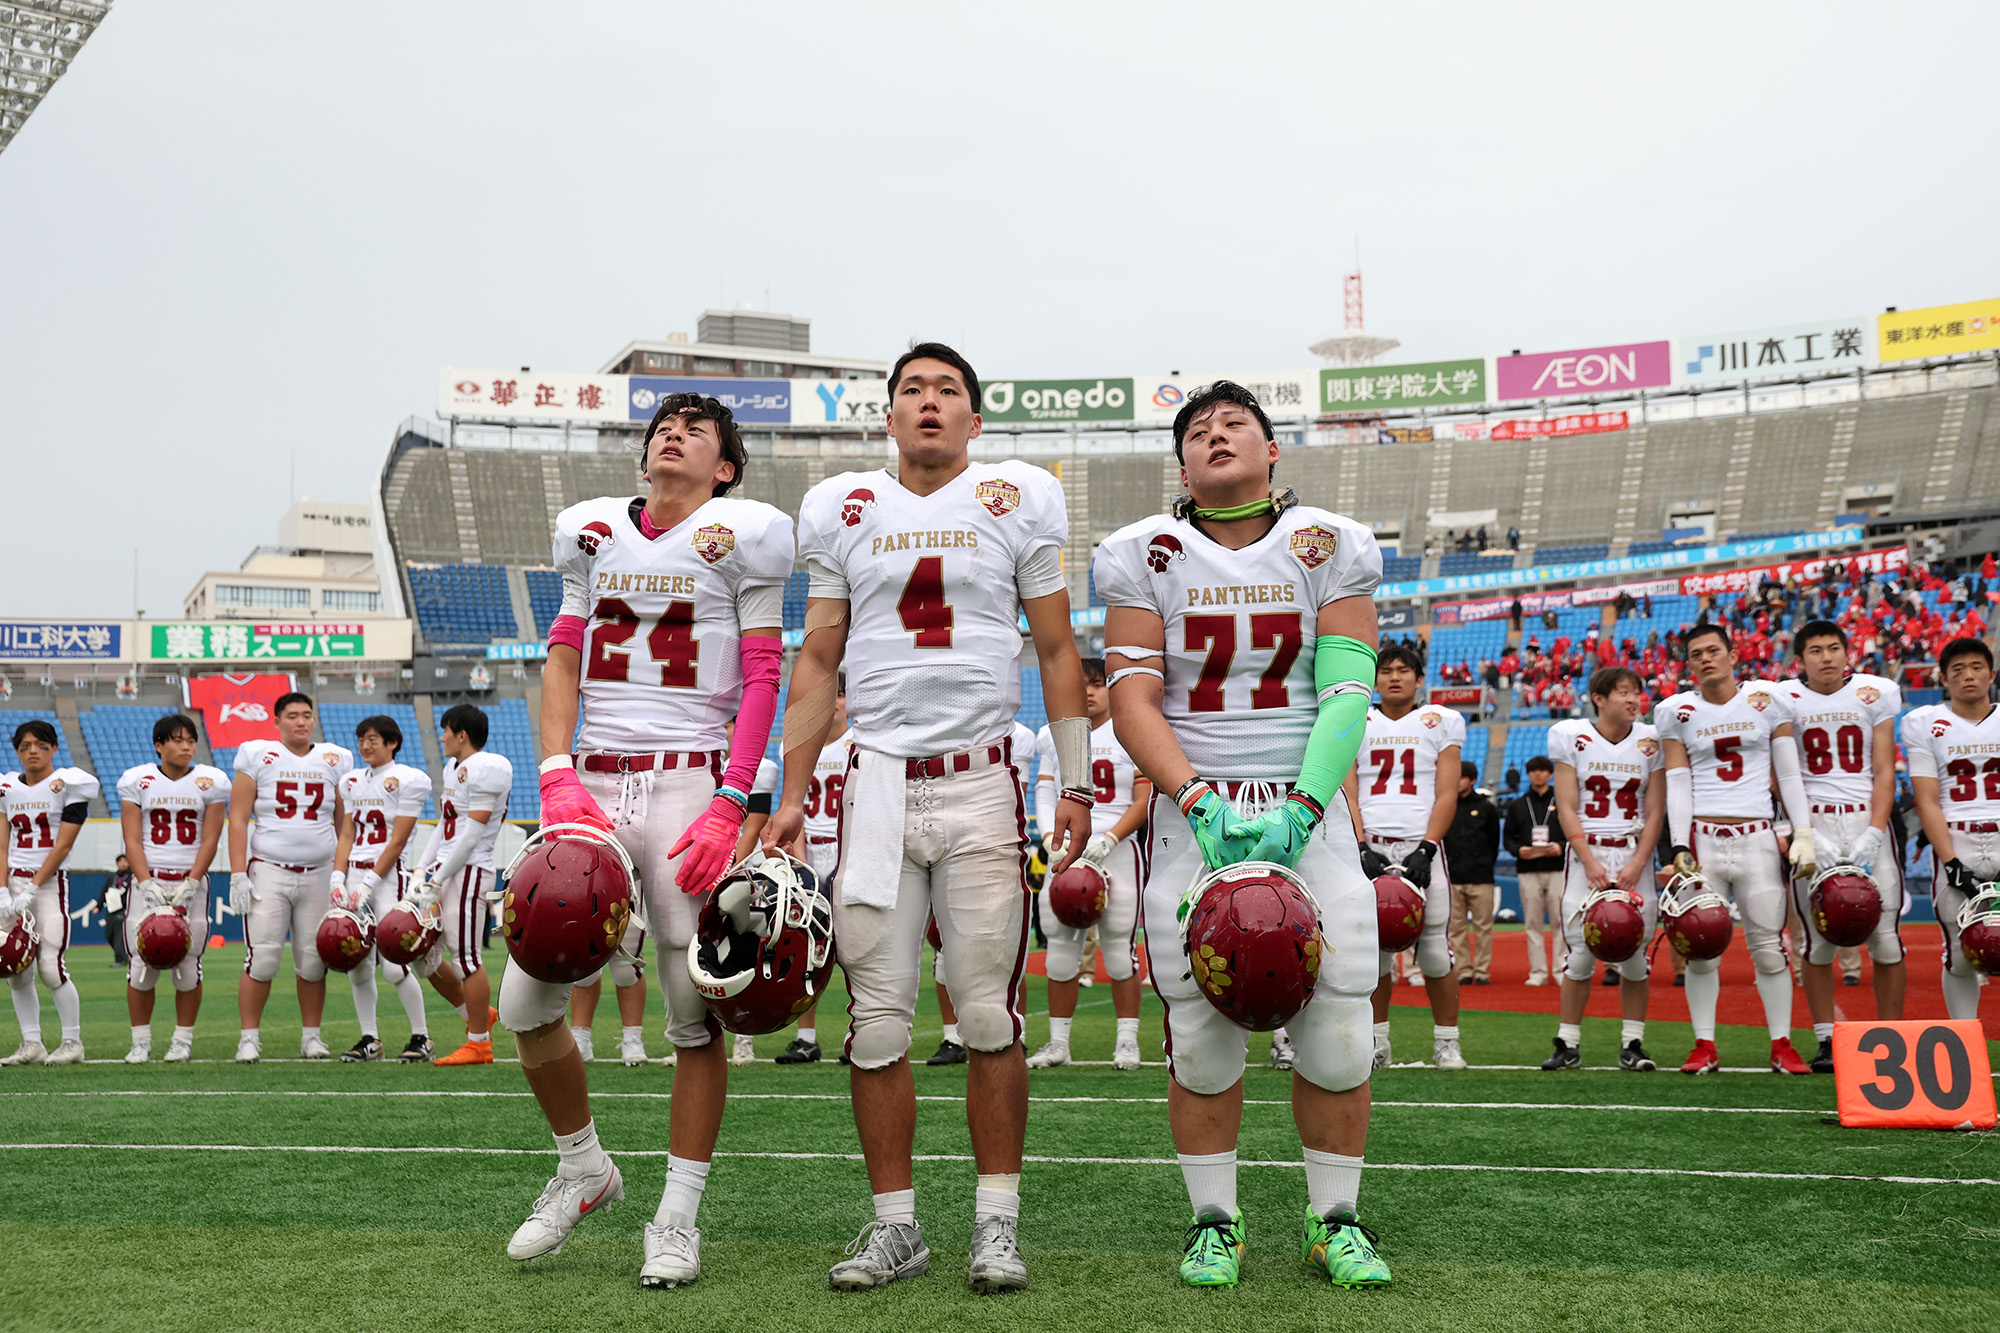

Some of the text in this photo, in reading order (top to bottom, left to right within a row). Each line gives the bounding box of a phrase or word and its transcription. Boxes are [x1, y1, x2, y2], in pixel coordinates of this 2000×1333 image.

[1886, 321, 1965, 345] 東洋水産
[1720, 327, 1862, 372] 川本工業
[1021, 381, 1126, 410] onedo
[1326, 369, 1480, 404] 関東学院大学
[976, 485, 1021, 508] PANTHERS
[691, 531, 736, 551] PANTHERS
[872, 530, 978, 555] PANTHERS
[1289, 534, 1337, 555] PANTHERS
[1793, 530, 1857, 550] SENDA
[596, 572, 695, 594] PANTHERS
[1187, 584, 1295, 606] PANTHERS
[896, 555, 954, 649] 4
[586, 597, 699, 689] 24
[1183, 612, 1303, 713] 77
[1696, 721, 1756, 739] PANTHERS
[1801, 711, 1860, 726] PANTHERS
[1369, 735, 1420, 746] PANTHERS
[1802, 725, 1864, 775] 80
[1588, 761, 1642, 774] PANTHERS
[1713, 735, 1743, 782] 5
[279, 771, 323, 780] PANTHERS
[1370, 749, 1417, 796] 71
[10, 801, 51, 811] PANTHERS
[150, 797, 198, 807] PANTHERS
[275, 781, 324, 821] 57
[352, 798, 385, 807] PANTHERS
[803, 774, 843, 819] 36
[1585, 774, 1642, 820] 34
[11, 812, 54, 848] 21
[150, 808, 198, 845] 86
[352, 809, 387, 846] 13
[1857, 1025, 1972, 1111] 30
